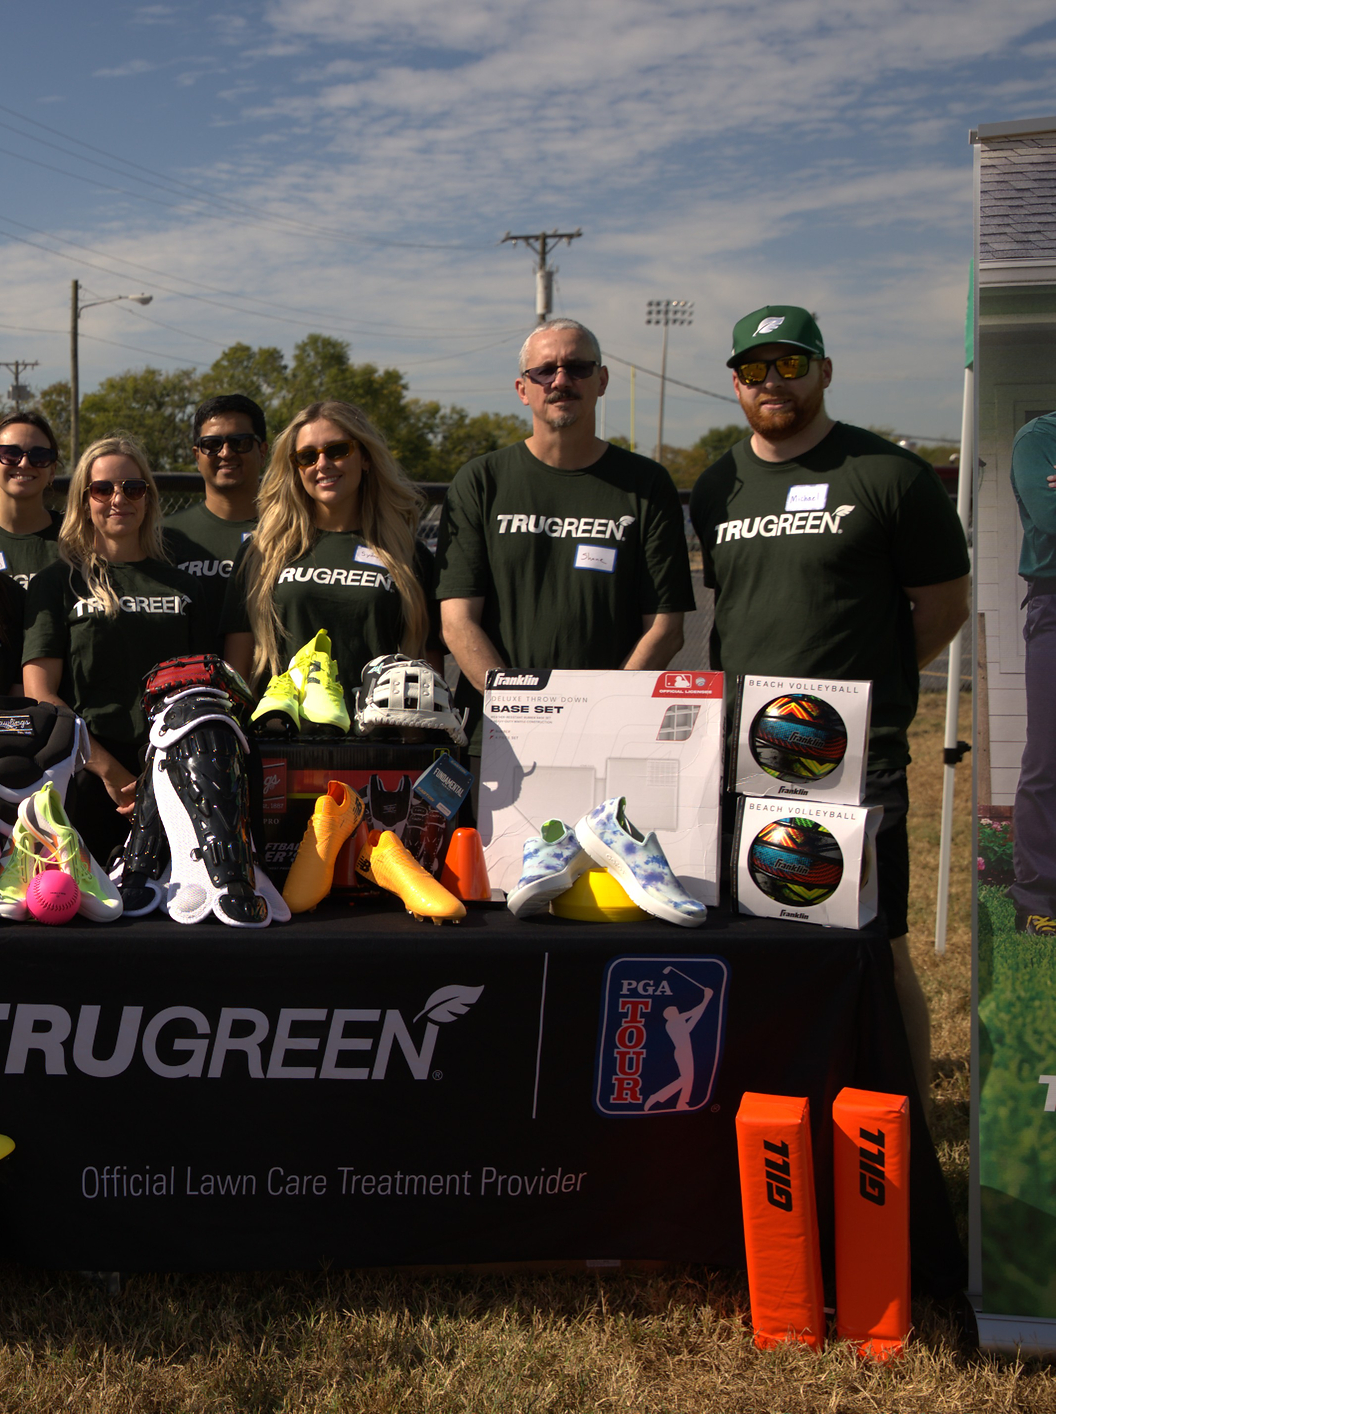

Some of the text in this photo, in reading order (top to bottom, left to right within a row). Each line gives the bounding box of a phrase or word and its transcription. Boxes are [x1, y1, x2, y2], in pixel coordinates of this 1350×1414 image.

[497, 513, 626, 542] TRUGREEN
[714, 510, 843, 545] TRUGREEN
[177, 559, 235, 578] TRUG
[278, 566, 395, 592] RUGREEN
[493, 672, 540, 687] Franklin
[748, 679, 860, 694] BEACH VOLLEYBALL
[491, 705, 564, 714] BASE SET
[789, 732, 825, 748] Franklin
[432, 767, 465, 798] FUNDAMENTAL
[777, 785, 809, 796] Franklin
[749, 803, 856, 820] BEACH VOLLEYBALL
[774, 858, 809, 875] Franklin
[779, 909, 809, 920] Franklin
[619, 979, 673, 996] PGA
[609, 997, 653, 1104] TOUR
[763, 1138, 793, 1213] GILL
[858, 1127, 886, 1207] GILL
[81, 1165, 587, 1199] Official Lawn Care Treatment Provider
